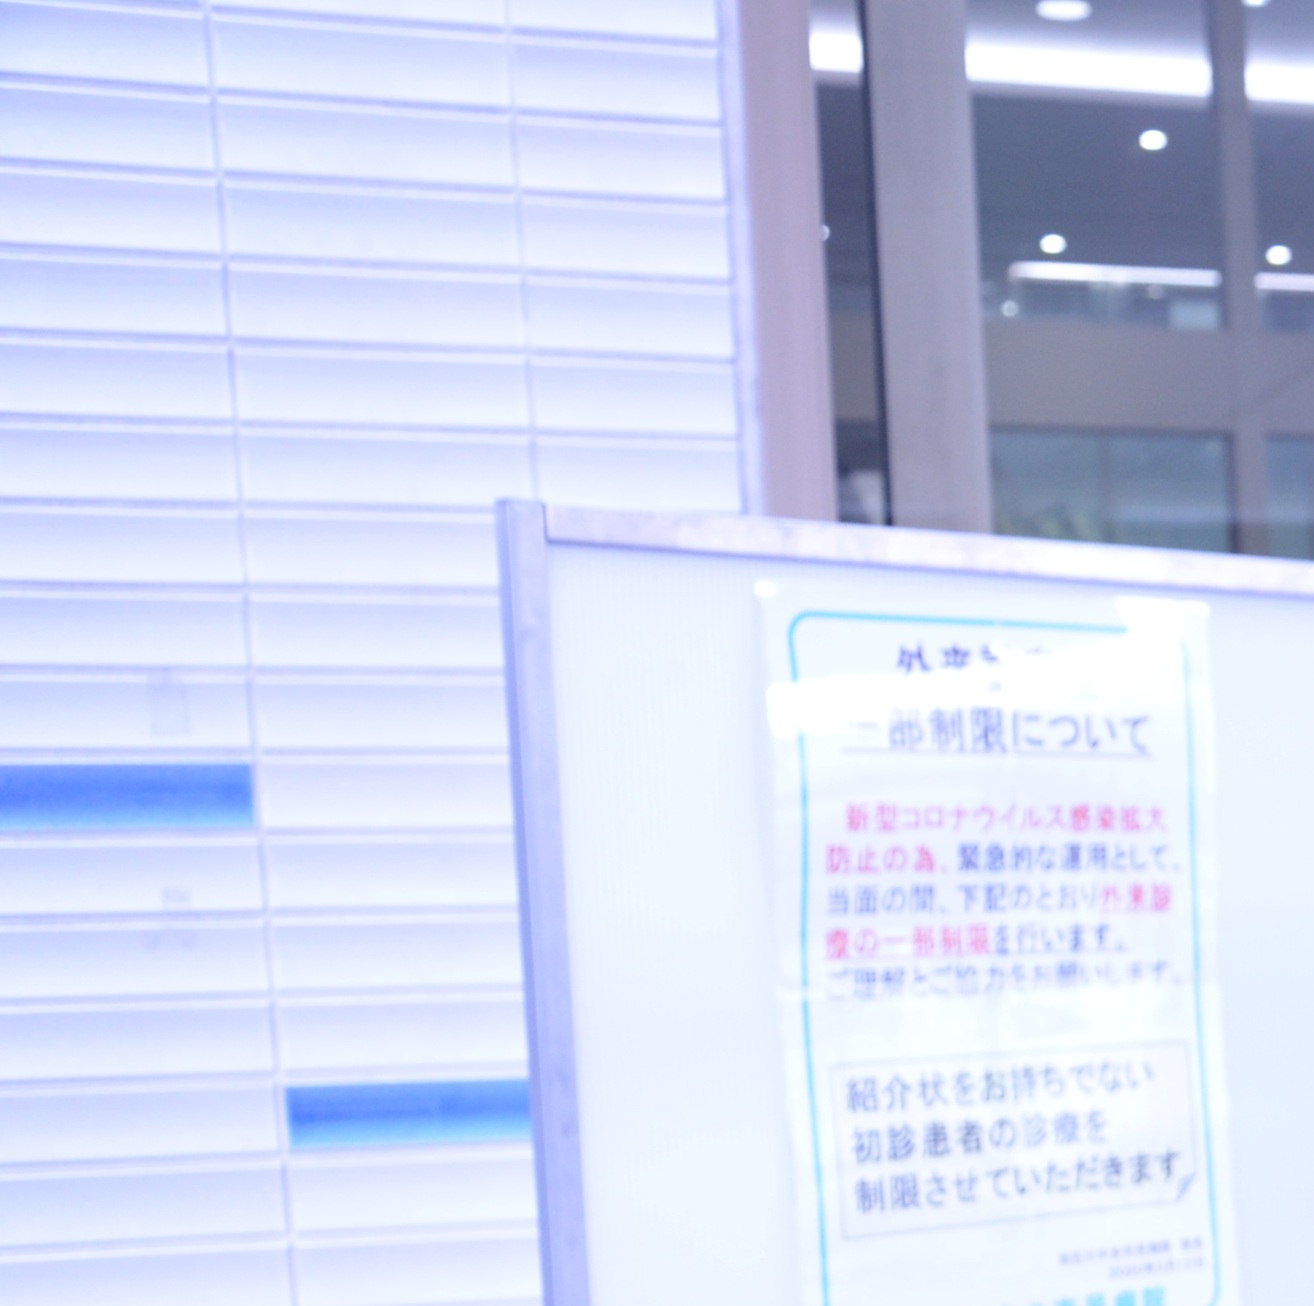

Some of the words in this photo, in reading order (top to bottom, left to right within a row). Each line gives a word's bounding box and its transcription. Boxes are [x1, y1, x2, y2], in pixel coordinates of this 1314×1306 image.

[845, 1058, 1155, 1113] 紹介状をお持ちでない
[851, 1108, 1110, 1165] 初診患者の診療を
